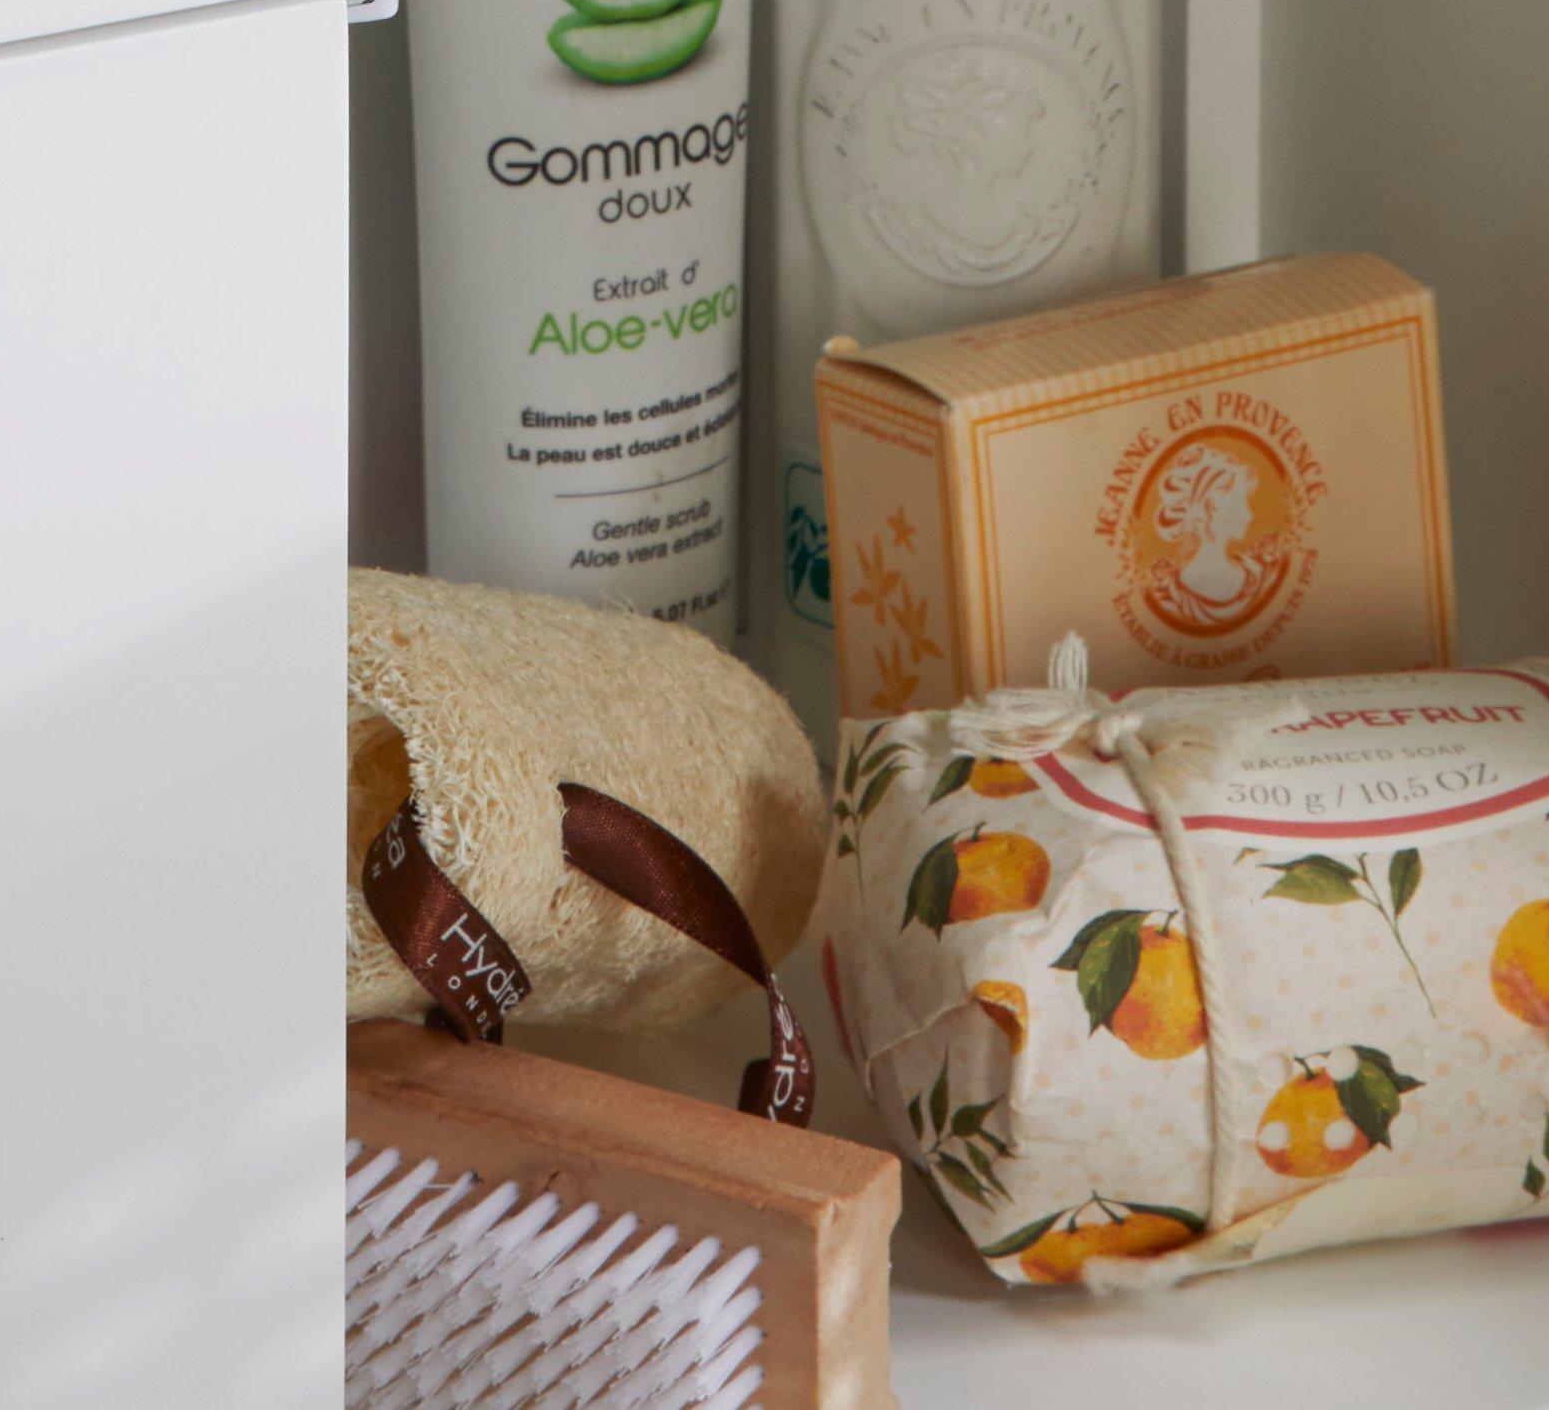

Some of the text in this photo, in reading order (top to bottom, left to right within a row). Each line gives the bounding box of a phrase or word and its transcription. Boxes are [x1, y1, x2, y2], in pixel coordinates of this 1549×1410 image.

[488, 102, 749, 186] Gommage
[598, 182, 692, 223] doux
[593, 269, 668, 302] Extrait
[527, 283, 739, 356] Aloe-vera
[521, 407, 597, 429] Élimine
[604, 408, 633, 426] les
[637, 391, 703, 421] cellules
[507, 425, 701, 466] La peau est douce et
[1095, 390, 1328, 546] JEANNE EN PROVENCE
[592, 497, 712, 541] Gentle scrub
[570, 517, 724, 569] Aloe vera extract
[1242, 741, 1466, 773] RAGRANCED SOAP
[1225, 761, 1500, 814] 300 g / 10,5 OZ
